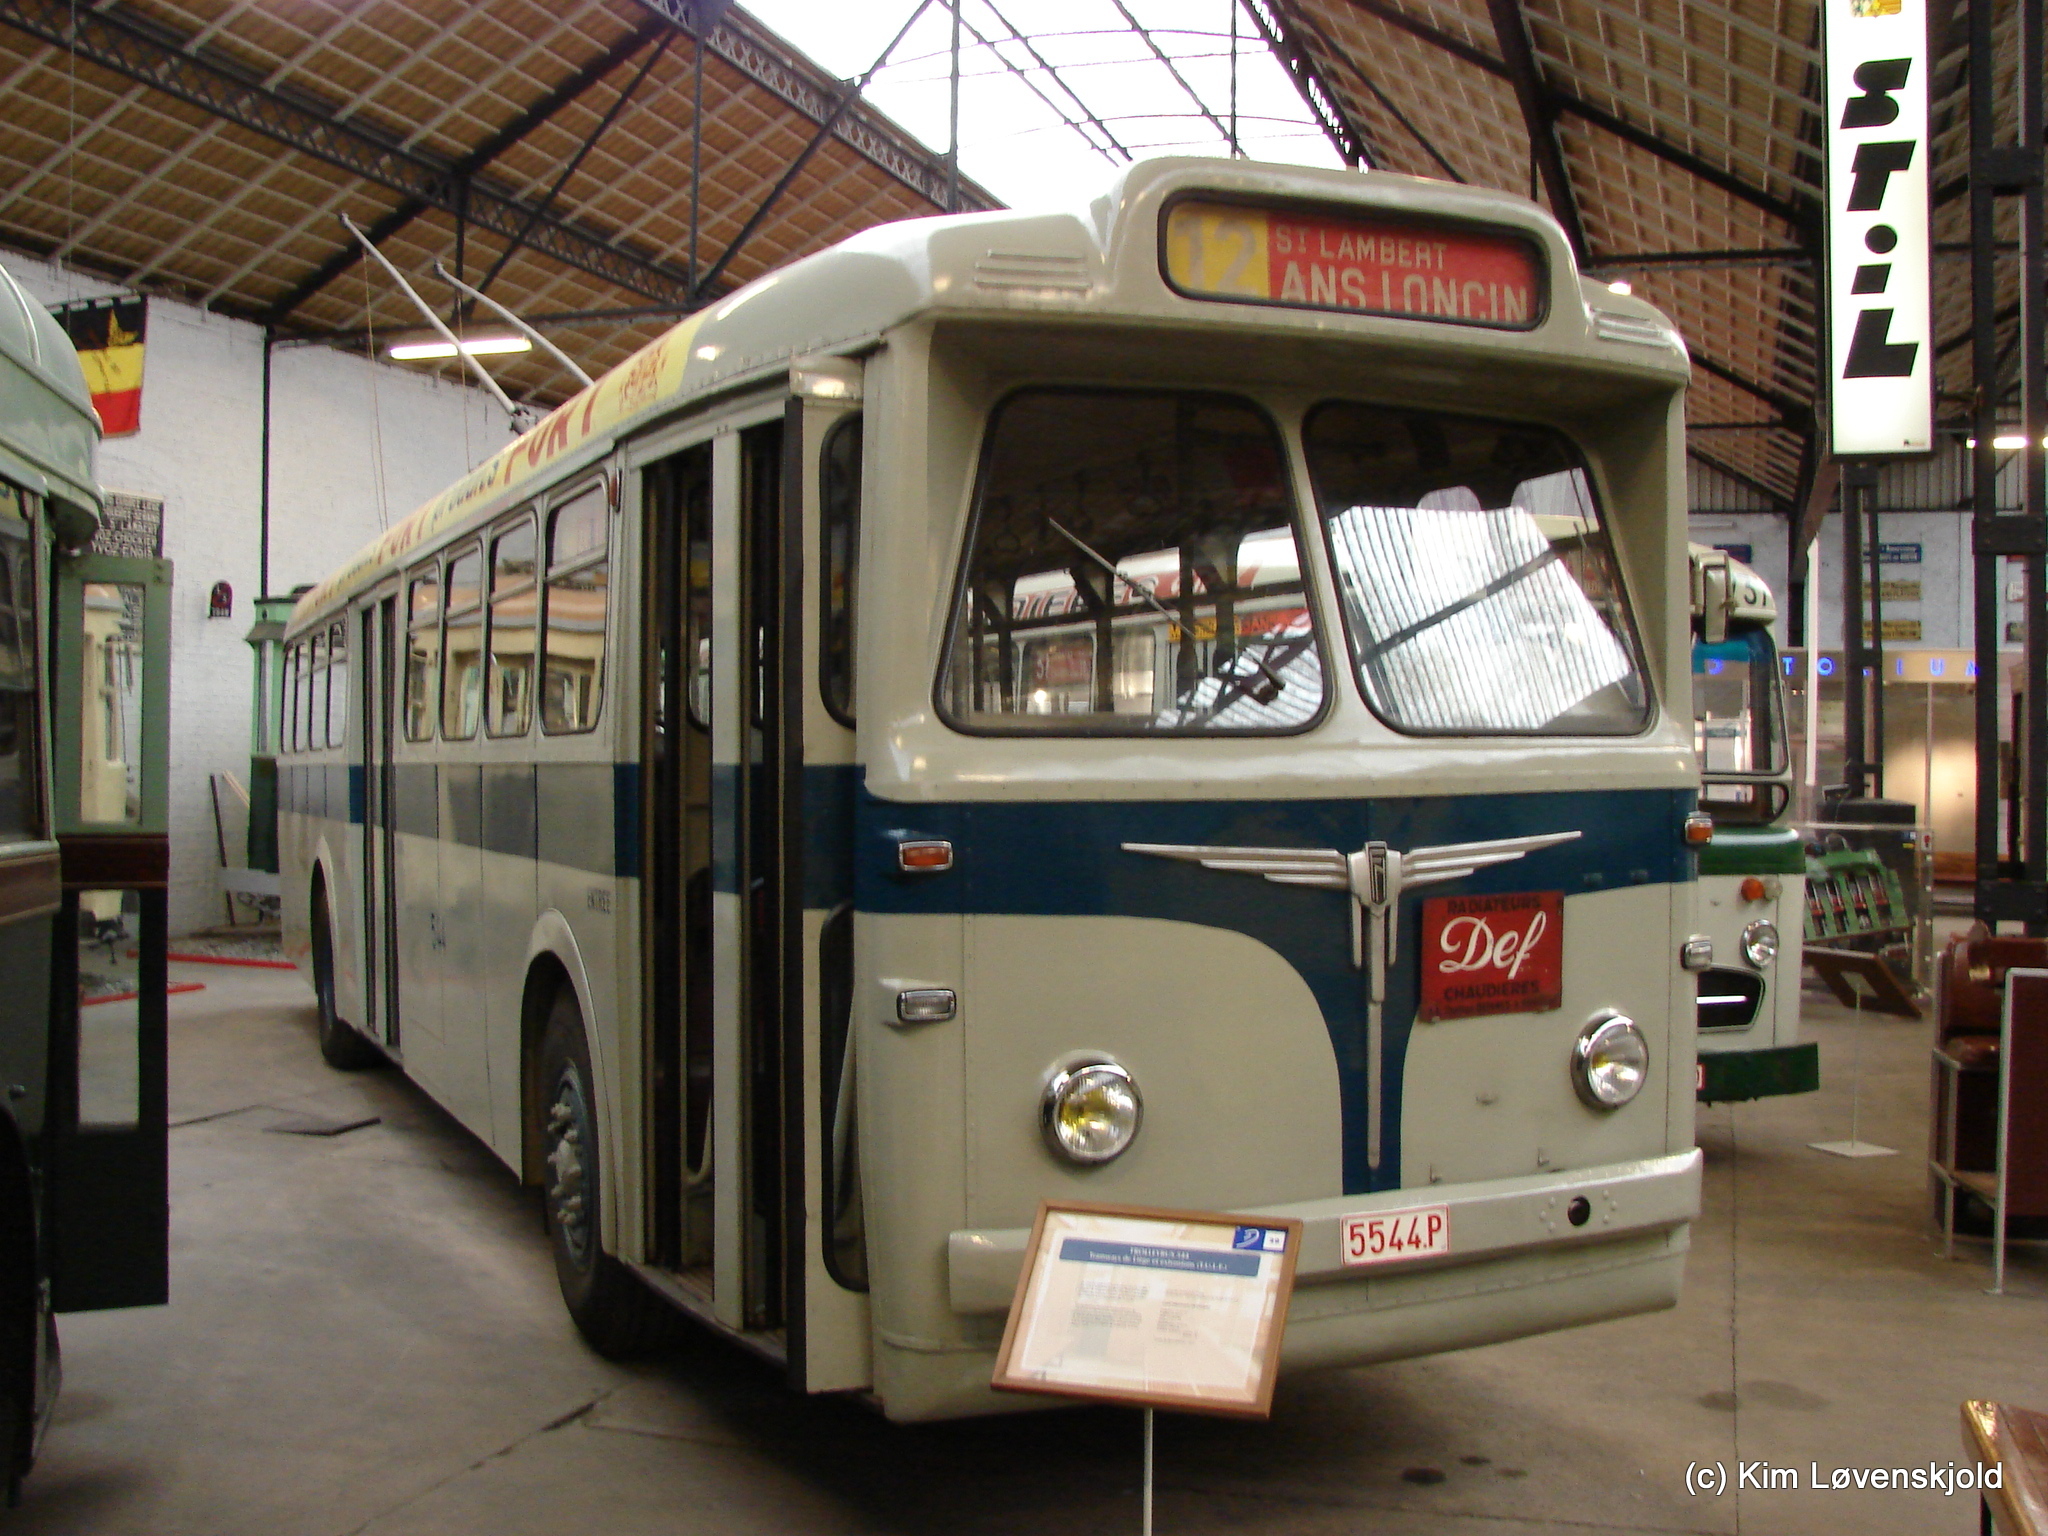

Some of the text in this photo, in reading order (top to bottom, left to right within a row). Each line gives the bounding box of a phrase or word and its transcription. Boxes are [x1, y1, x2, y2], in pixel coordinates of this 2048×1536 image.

[1174, 216, 1259, 296] 12
[1319, 229, 1447, 271] LAMBERT
[1281, 260, 1367, 310] ANS
[1439, 910, 1547, 980] Def
